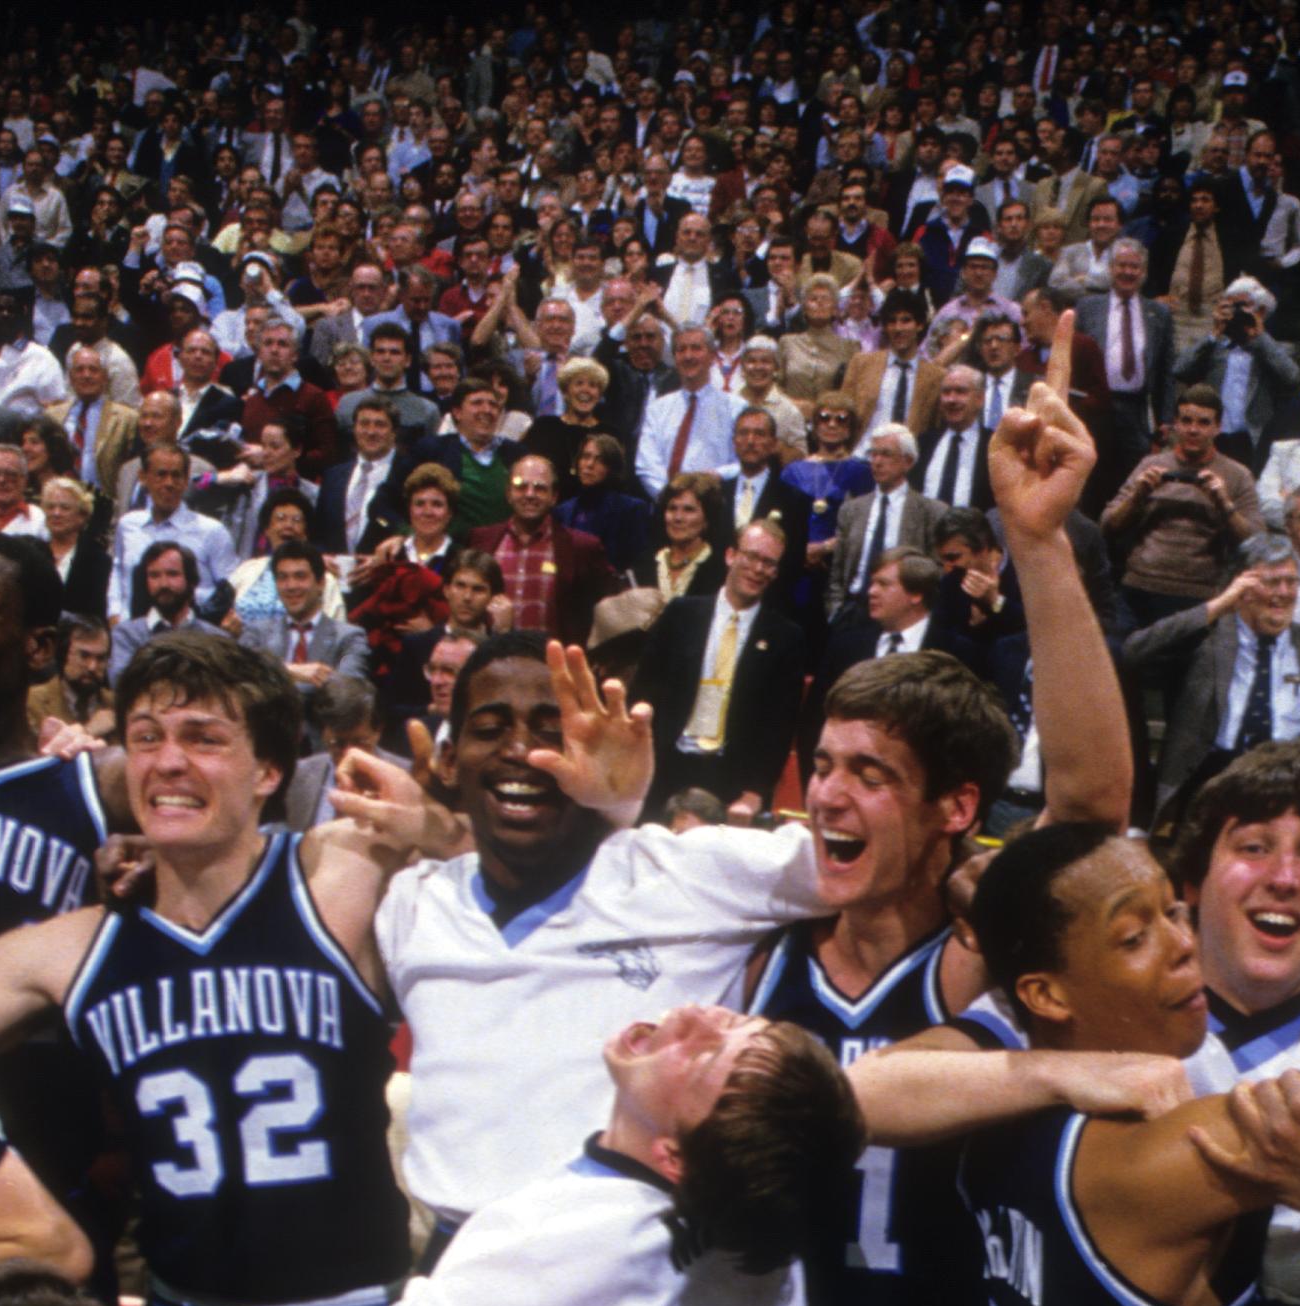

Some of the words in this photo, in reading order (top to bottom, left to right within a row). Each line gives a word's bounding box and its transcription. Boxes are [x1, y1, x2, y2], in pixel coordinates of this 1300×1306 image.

[84, 965, 345, 1077] VILLANOVA
[134, 1052, 334, 1197] 32
[843, 1144, 902, 1272] 1
